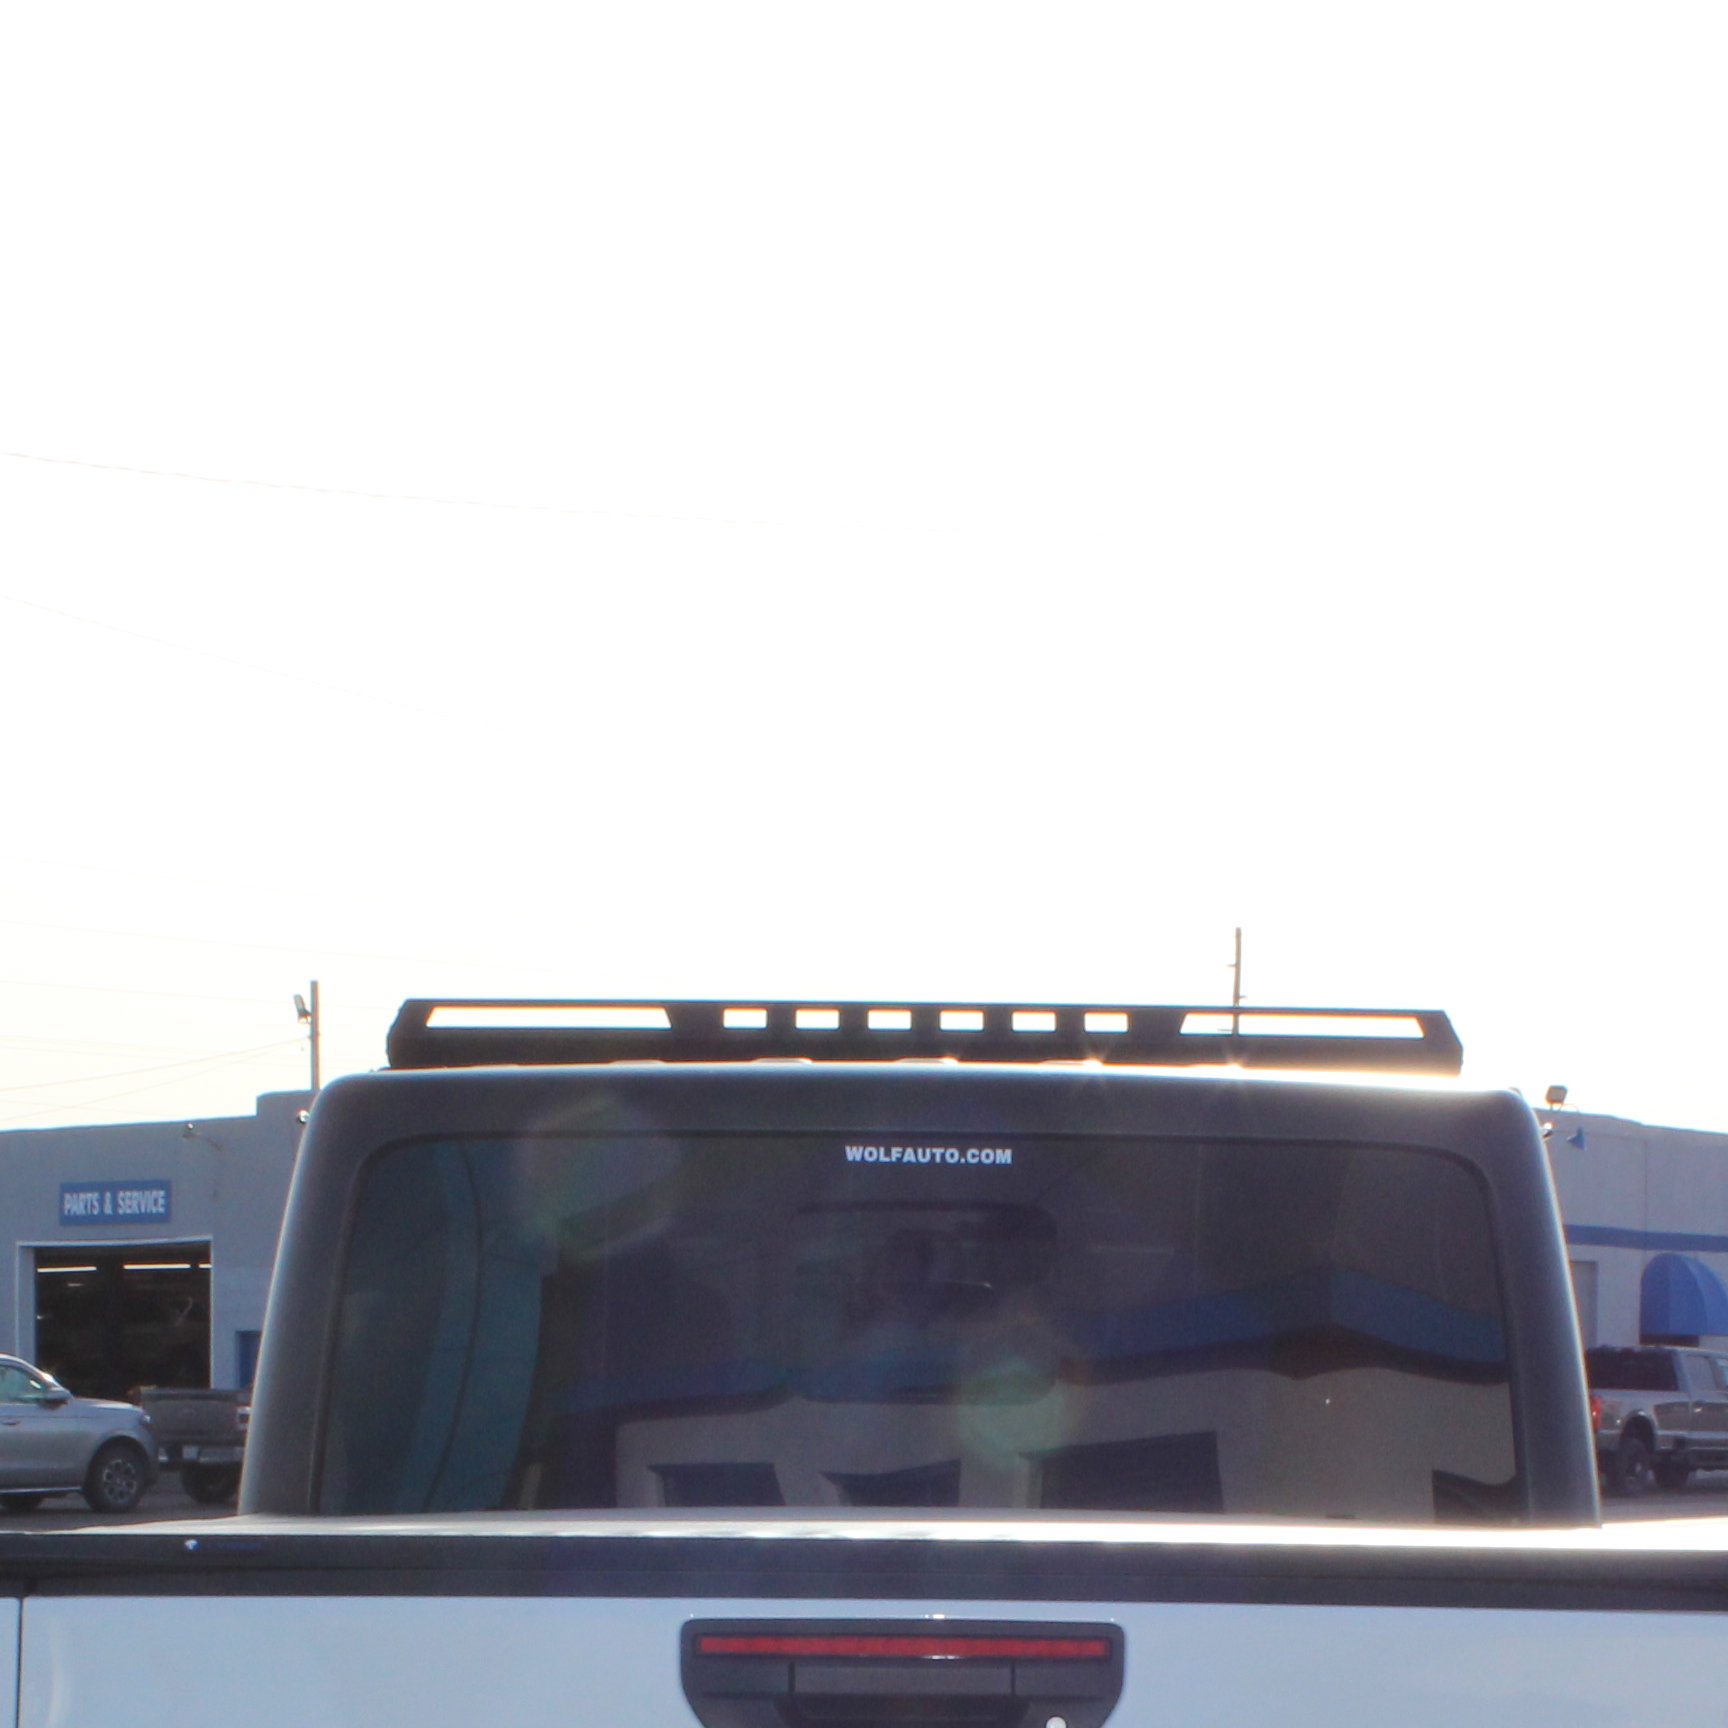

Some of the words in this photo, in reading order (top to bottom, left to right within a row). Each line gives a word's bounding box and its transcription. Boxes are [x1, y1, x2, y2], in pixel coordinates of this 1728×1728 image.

[845, 1145, 1012, 1164] WOLFAUTO.COM
[64, 1192, 99, 1215] PARTS
[103, 1192, 113, 1214] &
[117, 1190, 165, 1214] SERVICE
